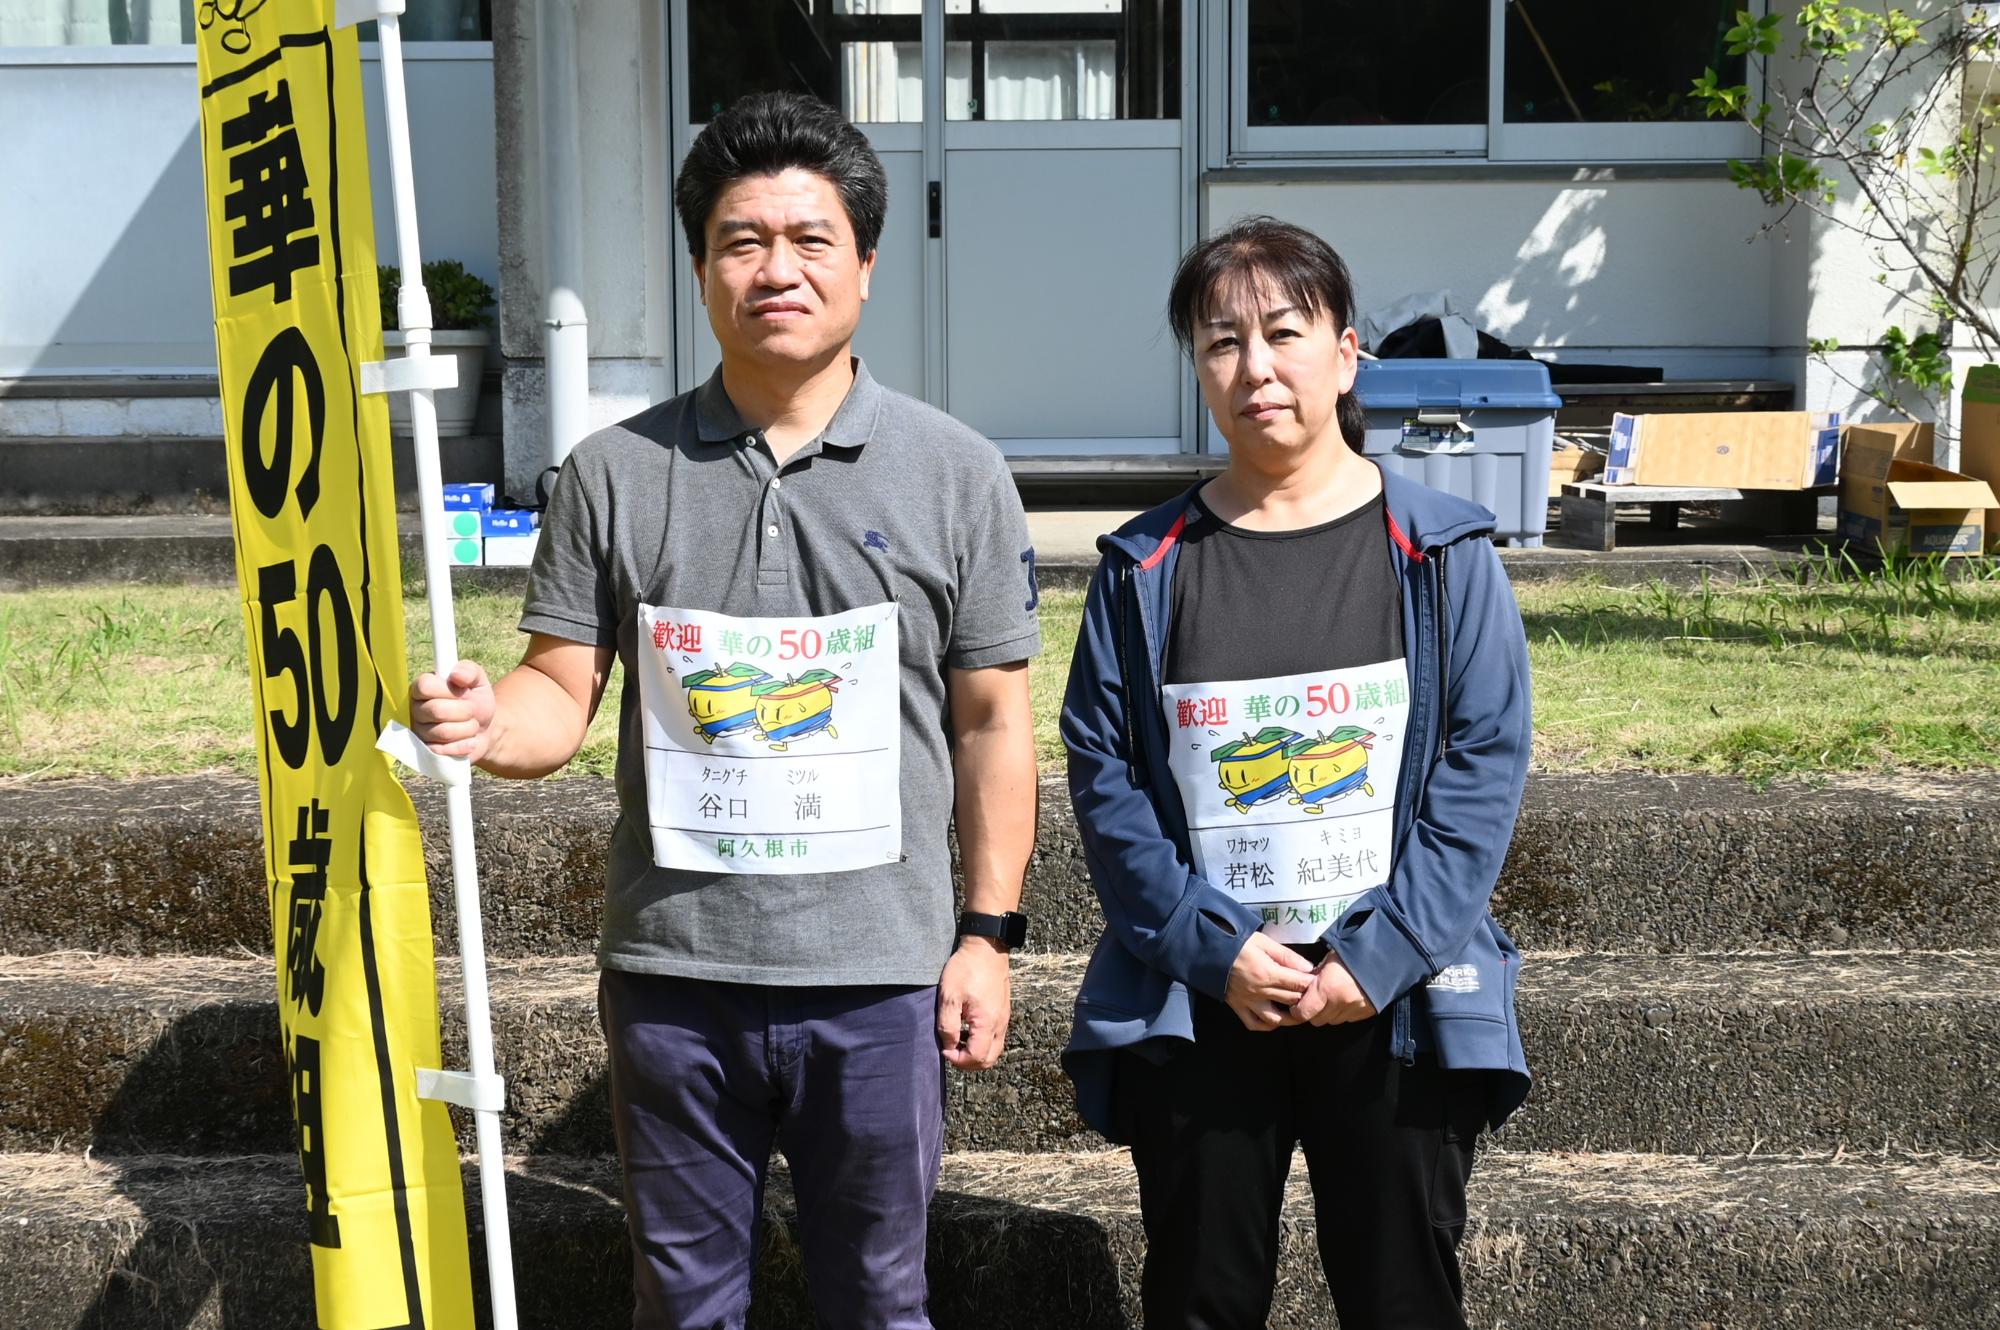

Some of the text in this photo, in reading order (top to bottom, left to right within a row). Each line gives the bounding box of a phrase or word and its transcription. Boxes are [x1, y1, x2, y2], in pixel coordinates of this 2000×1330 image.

[652, 620, 876, 661] 歓迎 華の50歳組
[1176, 677, 1408, 729] 歓迎 華の50歳組
[786, 768, 820, 785] ミツル
[698, 792, 822, 821] 谷口 満
[717, 838, 808, 859] 阿久根市
[1226, 826, 1362, 854] ワカマツ キミヨ
[1224, 848, 1378, 890] 若松 紀美代
[1261, 900, 1348, 925] 阿久根市
